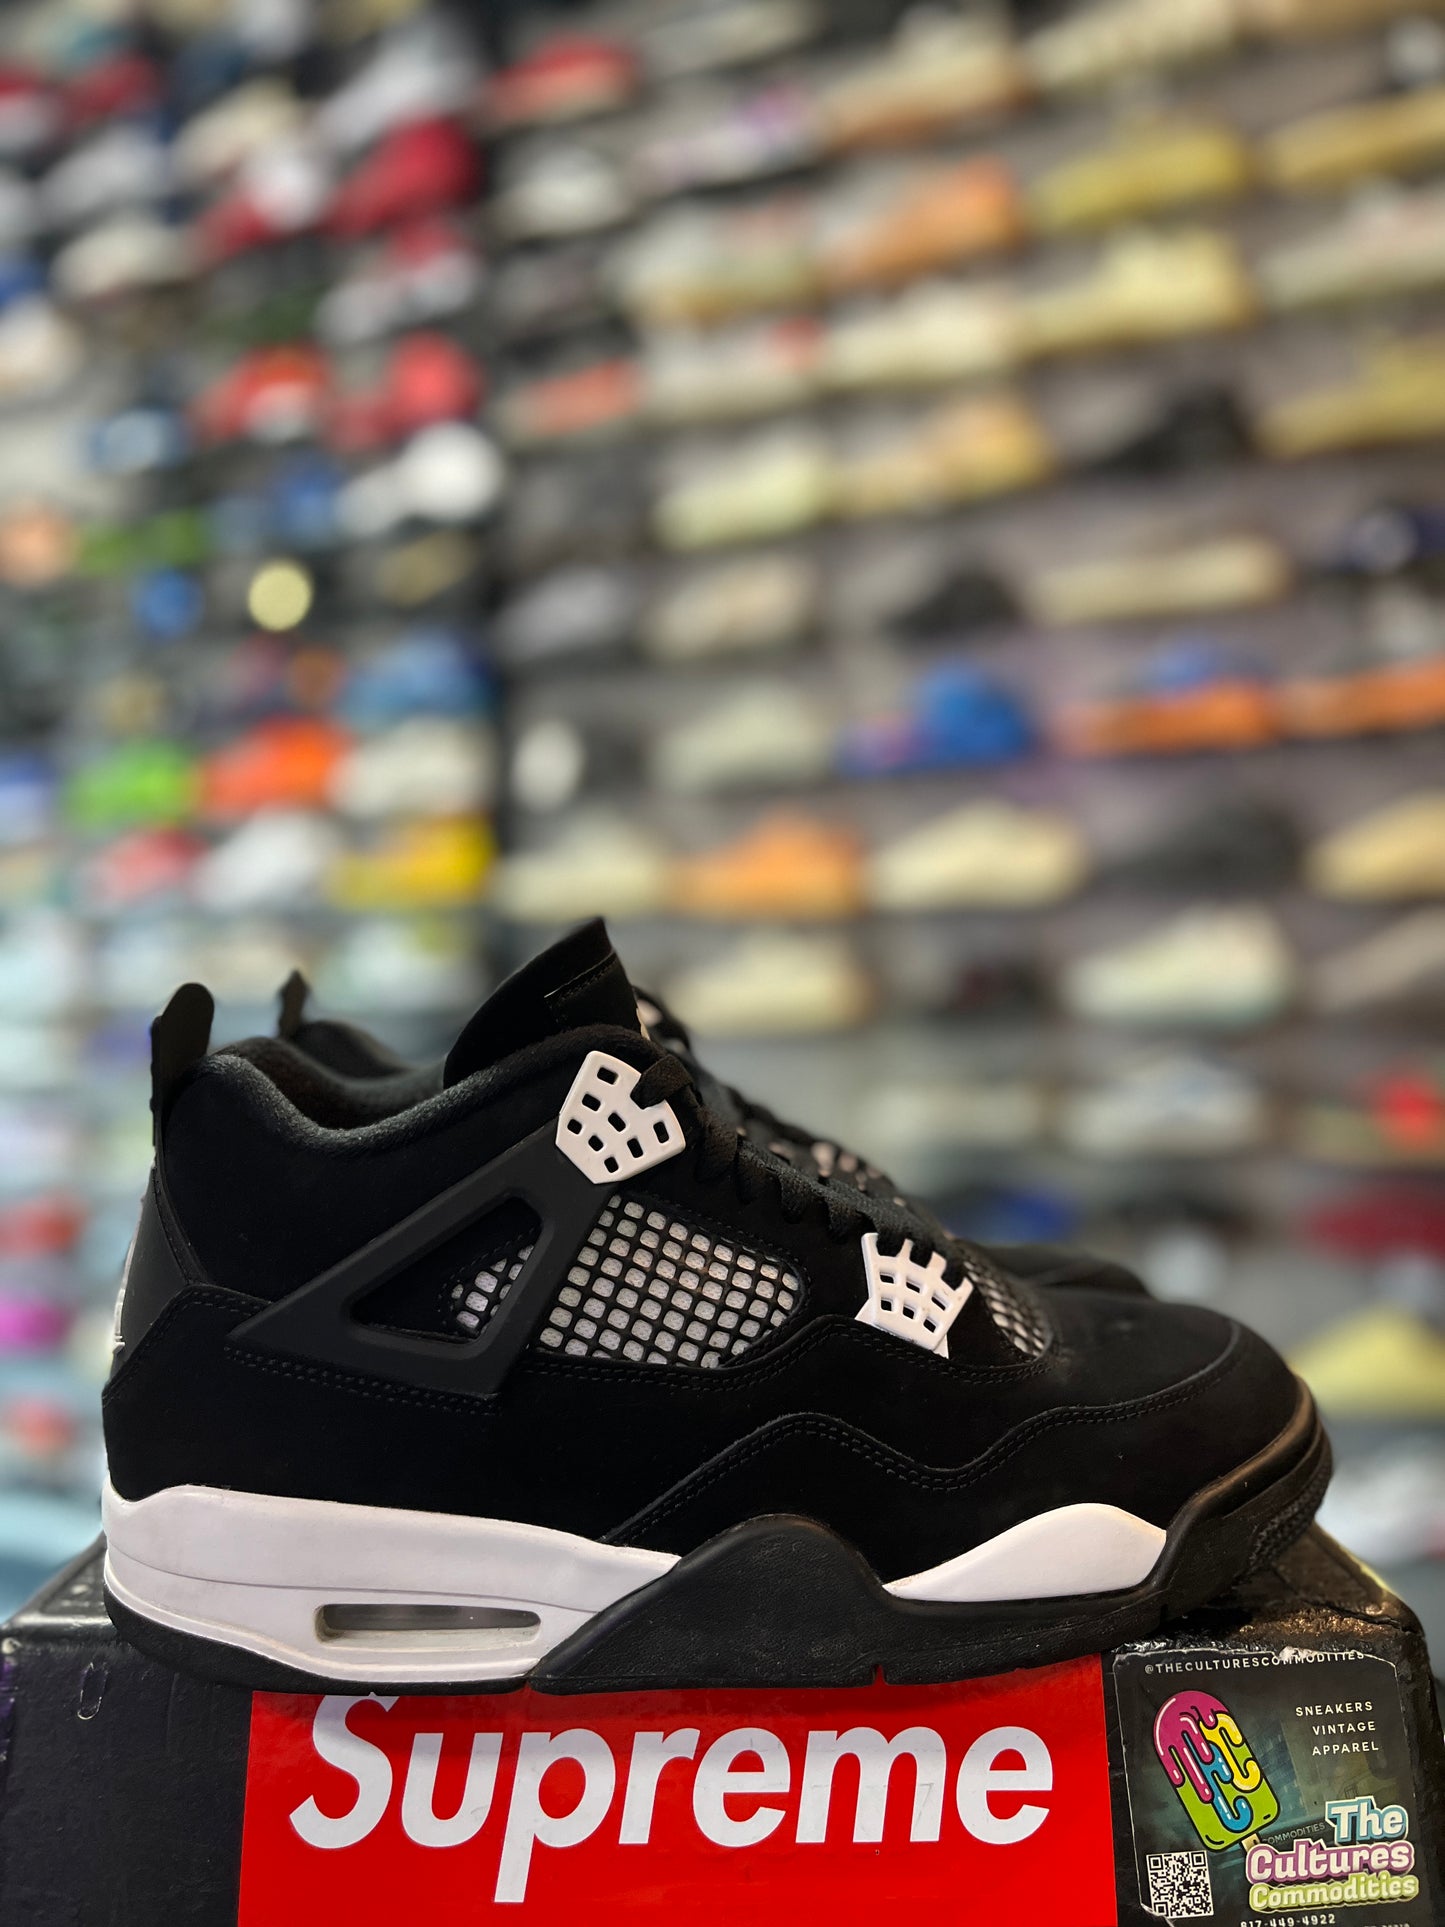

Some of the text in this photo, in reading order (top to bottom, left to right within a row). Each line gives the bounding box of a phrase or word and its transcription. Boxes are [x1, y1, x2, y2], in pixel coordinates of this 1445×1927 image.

[1295, 1701, 1373, 1717] SNEAKERS
[1312, 1721, 1377, 1736] VINTAGE
[1312, 1741, 1380, 1756] APPAREL
[289, 1694, 1053, 1903] Supreme
[1330, 1801, 1404, 1840] The
[1250, 1844, 1411, 1881] Cultures
[1252, 1874, 1416, 1908] Commodities
